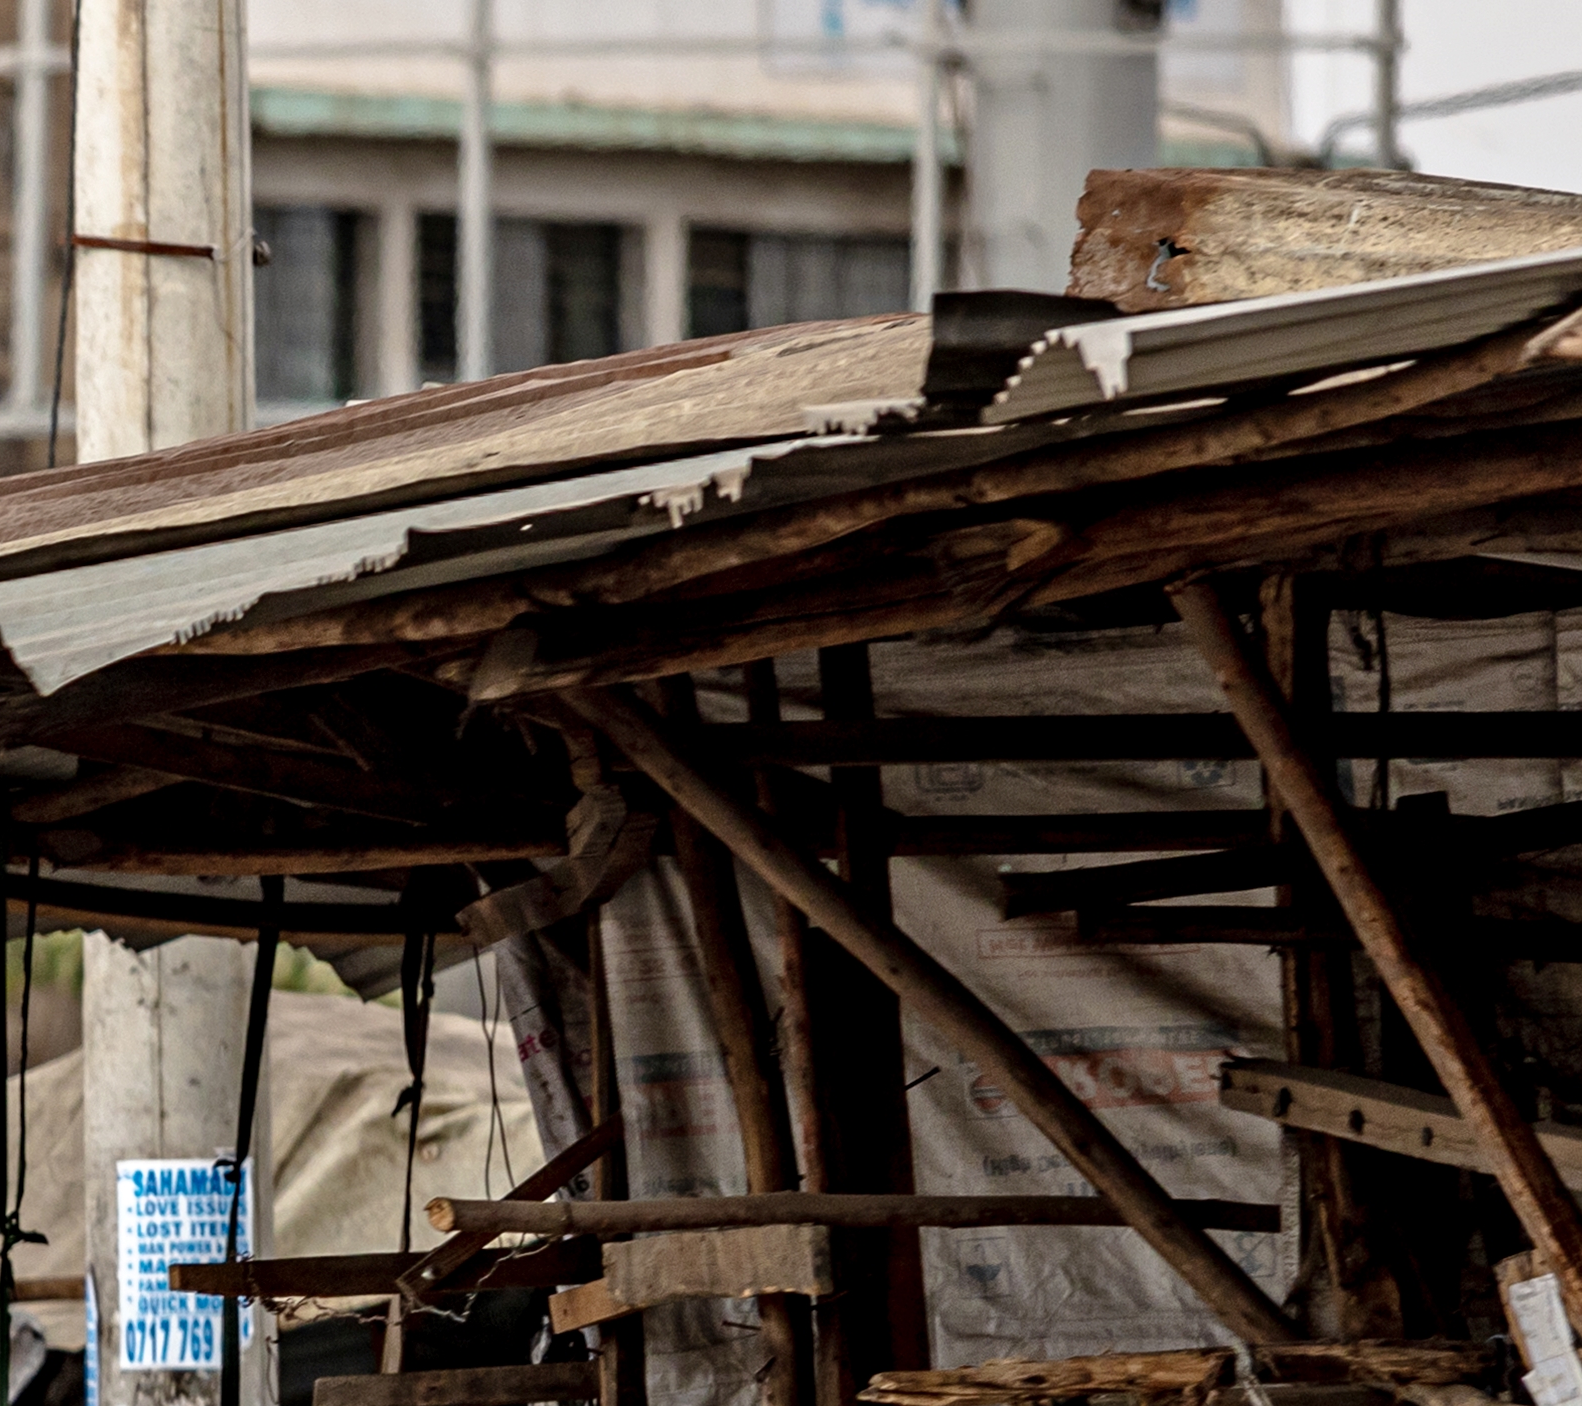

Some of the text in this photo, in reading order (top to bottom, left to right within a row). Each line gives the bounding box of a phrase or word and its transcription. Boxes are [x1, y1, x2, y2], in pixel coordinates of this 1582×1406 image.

[136, 1200, 247, 1217] LOVE ISSUS
[137, 1221, 181, 1238] LOST
[170, 1242, 211, 1254] POWER
[138, 1295, 188, 1313] QUICK
[126, 1318, 170, 1363] 0717
[179, 1318, 213, 1361] 769
